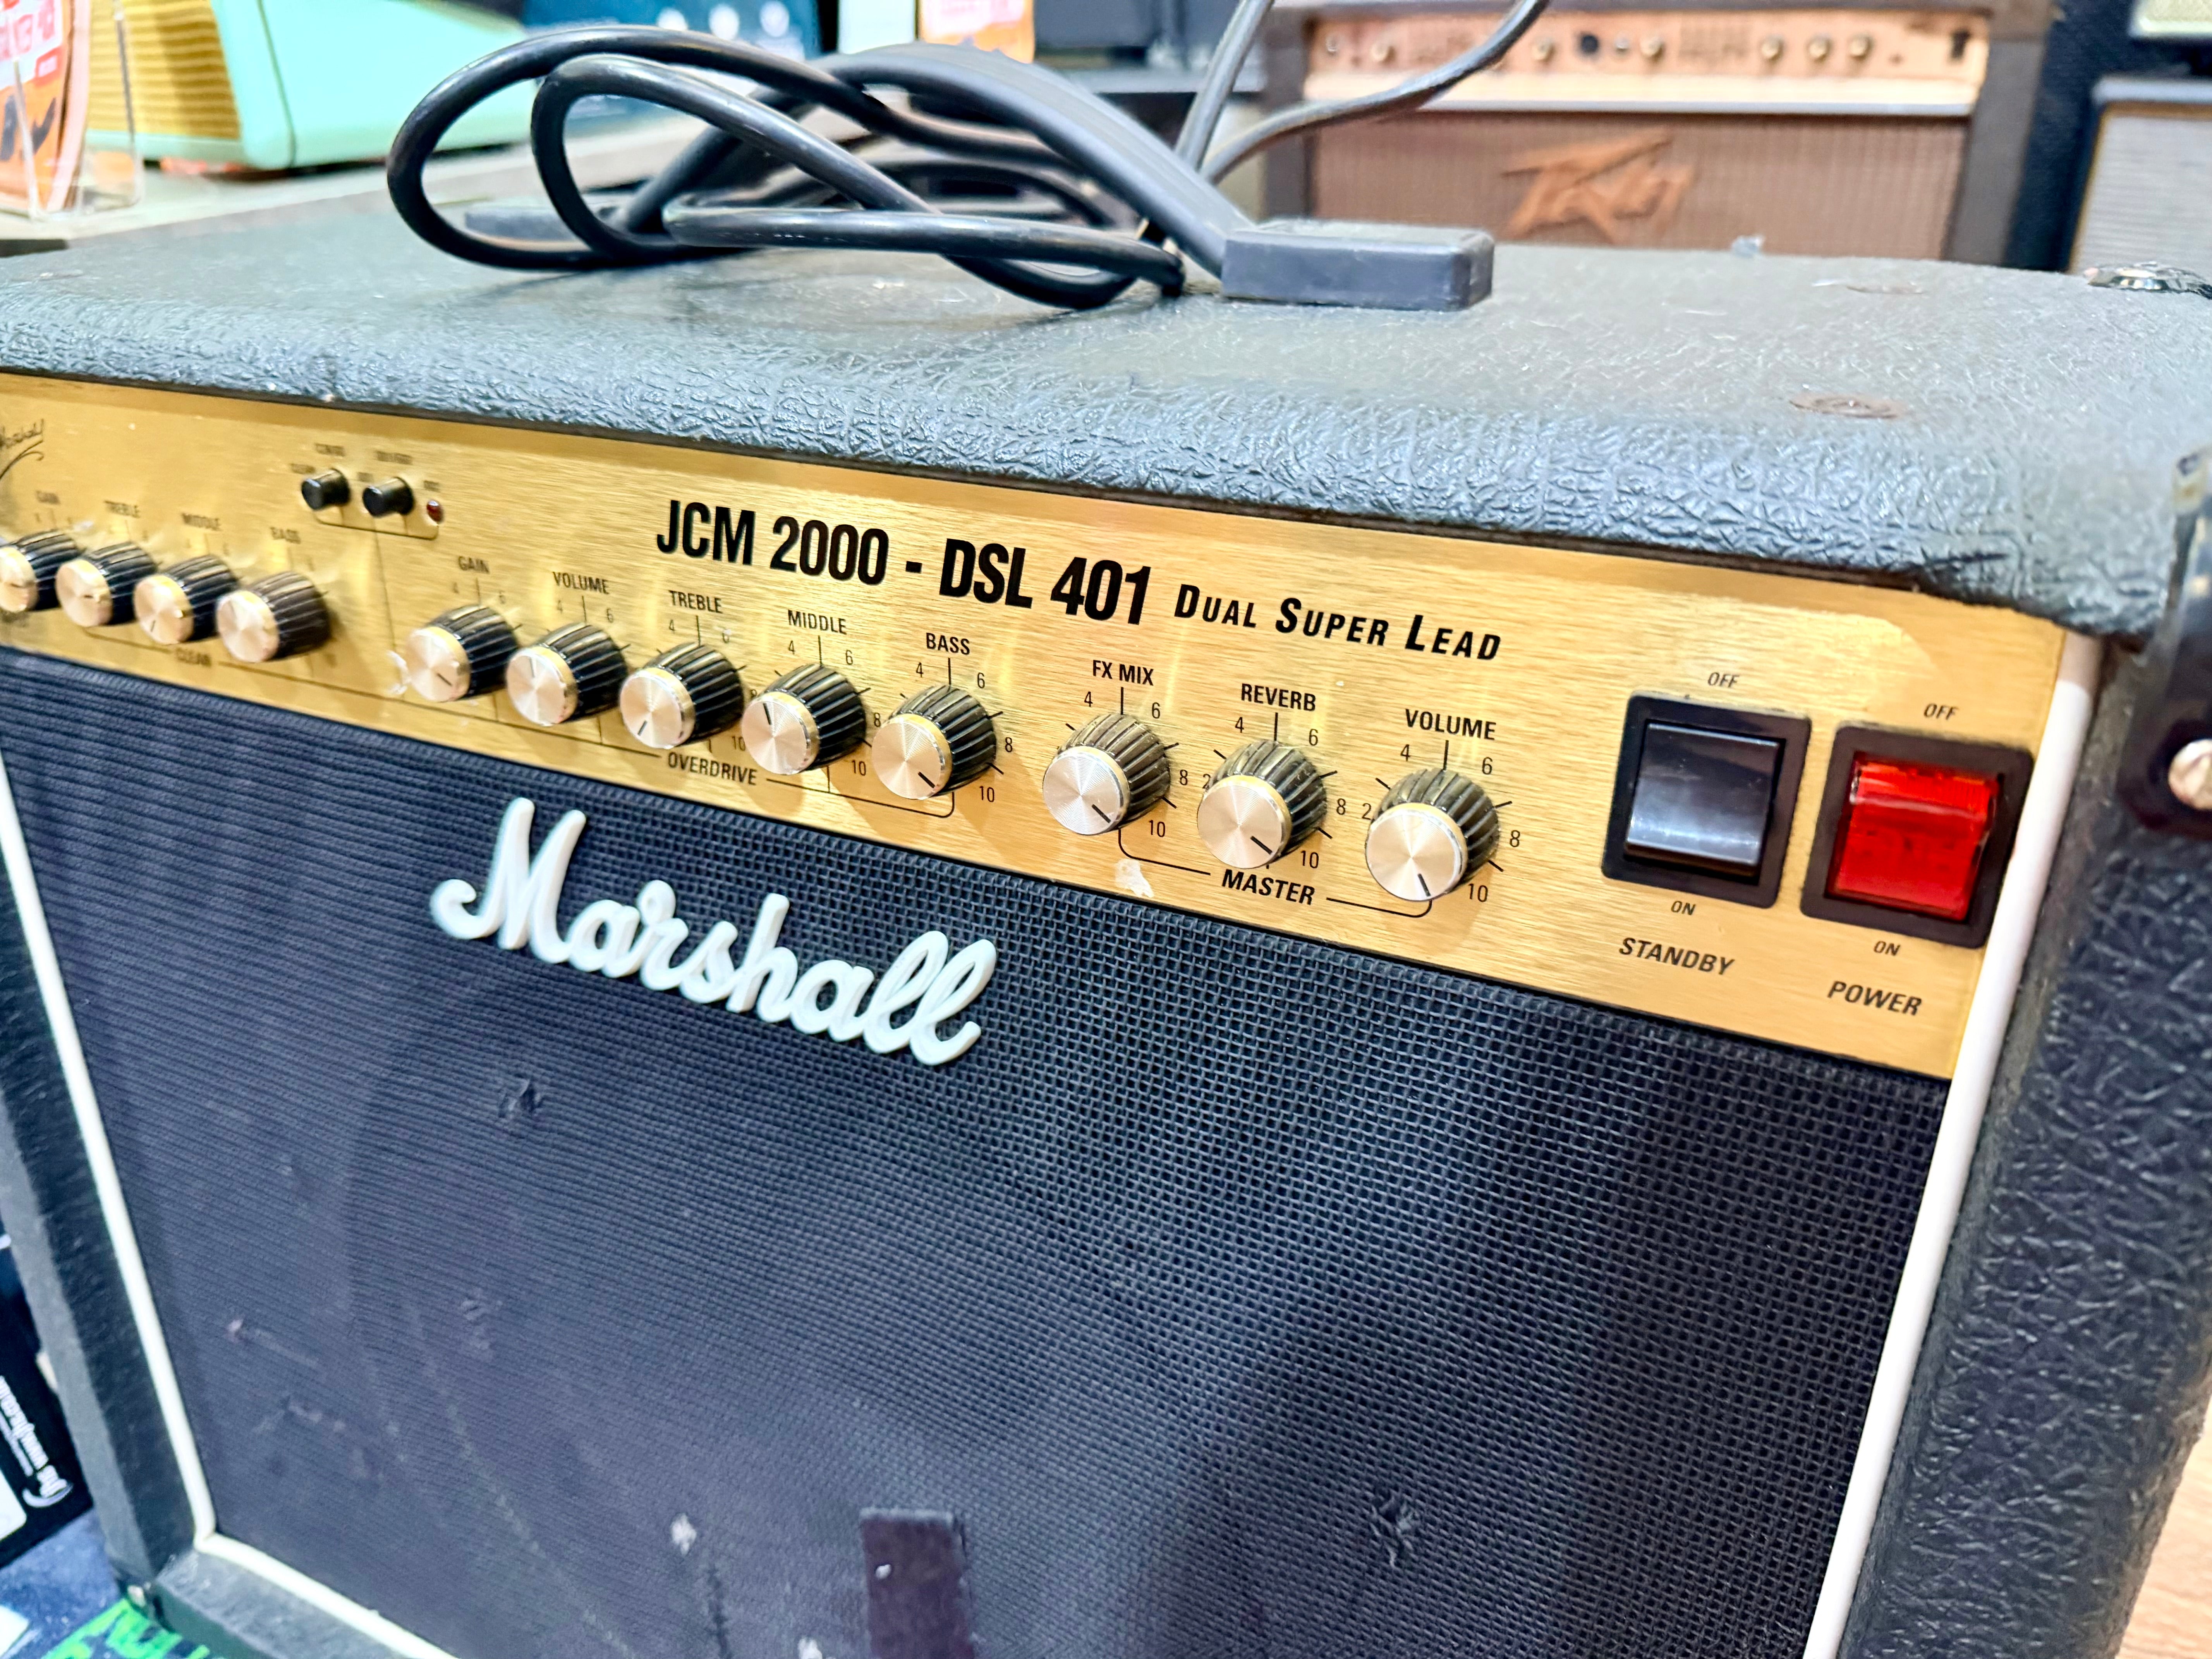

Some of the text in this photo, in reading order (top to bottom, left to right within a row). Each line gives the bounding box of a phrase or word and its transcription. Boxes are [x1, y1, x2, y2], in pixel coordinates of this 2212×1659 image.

[458, 556, 489, 573] GAIN
[657, 500, 755, 565] JCM
[770, 516, 888, 585] 2000
[906, 561, 922, 573] -
[939, 539, 1032, 608] DSL
[1051, 557, 1151, 625] 401
[553, 572, 608, 594] VOLUME
[669, 590, 722, 613] TREBLE
[606, 608, 613, 623] 6
[788, 610, 846, 634] MIDDLE
[669, 620, 675, 632] 4
[788, 641, 795, 654] 4
[926, 633, 969, 655] BASS
[845, 650, 853, 665] 6
[916, 662, 923, 677] 4
[1093, 660, 1153, 685] FX MIX
[977, 673, 985, 689] 6
[1707, 672, 1740, 689] OFF
[1084, 692, 1092, 707] 4
[1242, 684, 1315, 711] REVERB
[1152, 702, 1160, 718] 6
[1923, 703, 1958, 720] OFF
[873, 713, 881, 727] 8
[1235, 717, 1244, 733] 4
[1406, 709, 1496, 740] VOLUME
[731, 735, 745, 750] 10
[1005, 737, 1013, 752] 8
[1309, 729, 1318, 746] 6
[1401, 744, 1410, 761] 4
[668, 752, 756, 785] OVERDRIVE
[852, 760, 866, 776] 10
[1482, 757, 1492, 775] 6
[1180, 770, 1188, 785] 8
[980, 786, 994, 802] 10
[1336, 799, 1346, 815] 8
[1362, 803, 1372, 819] 2
[1149, 820, 1165, 837] 10
[1510, 830, 1520, 847] 8
[1301, 850, 1319, 868] 10
[1222, 869, 1314, 905] MASTER
[1469, 883, 1488, 902] 10
[1671, 901, 1695, 915] ON
[429, 797, 997, 1066] Marshall
[1620, 938, 1734, 974] STANDBY
[1874, 941, 1900, 955] ON
[1828, 981, 1922, 1015] POWER
